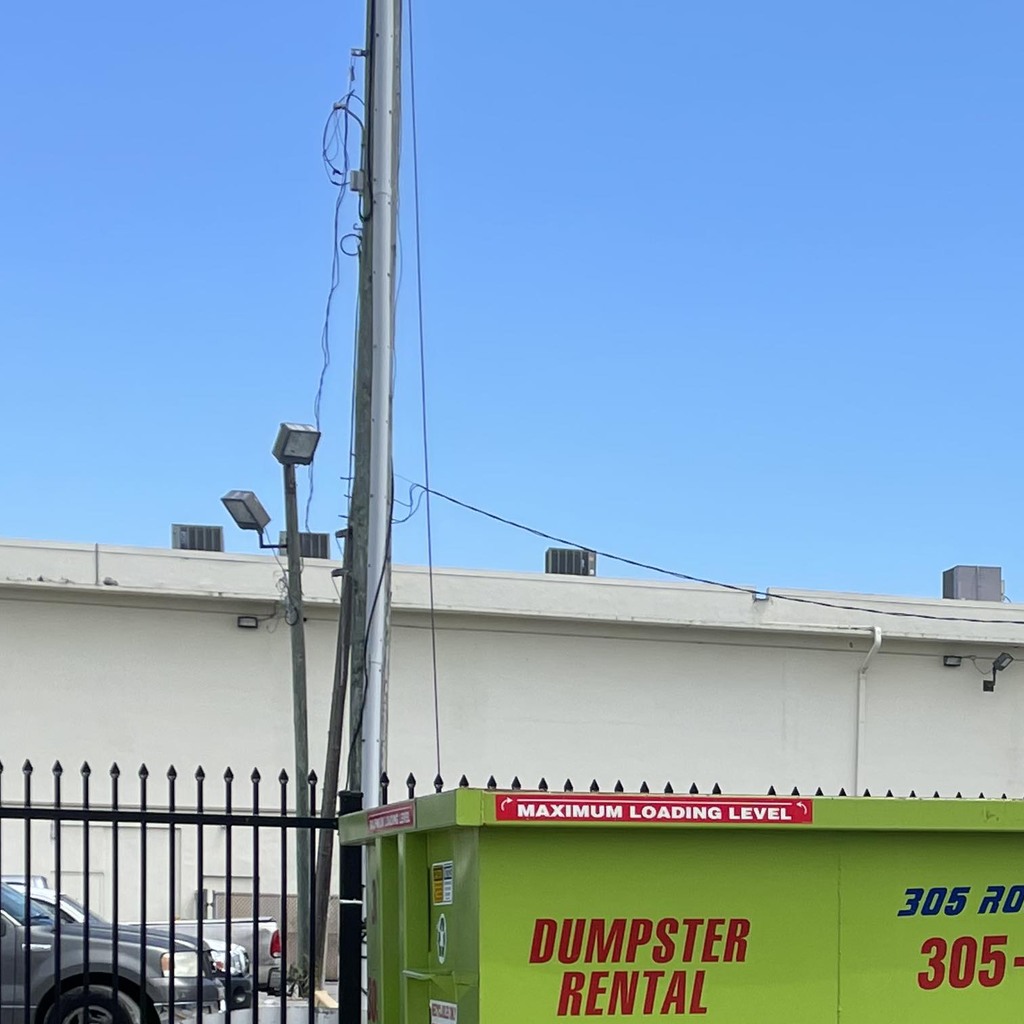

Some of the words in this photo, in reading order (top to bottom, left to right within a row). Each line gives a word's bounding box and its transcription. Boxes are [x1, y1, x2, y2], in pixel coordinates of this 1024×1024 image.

[517, 804, 623, 819] MAXIMUM
[629, 805, 722, 820] LOADING
[729, 807, 792, 821] LEVEL
[897, 886, 970, 917] 305
[529, 916, 751, 964] DUMPSTER
[557, 969, 708, 1017] RENTAL
